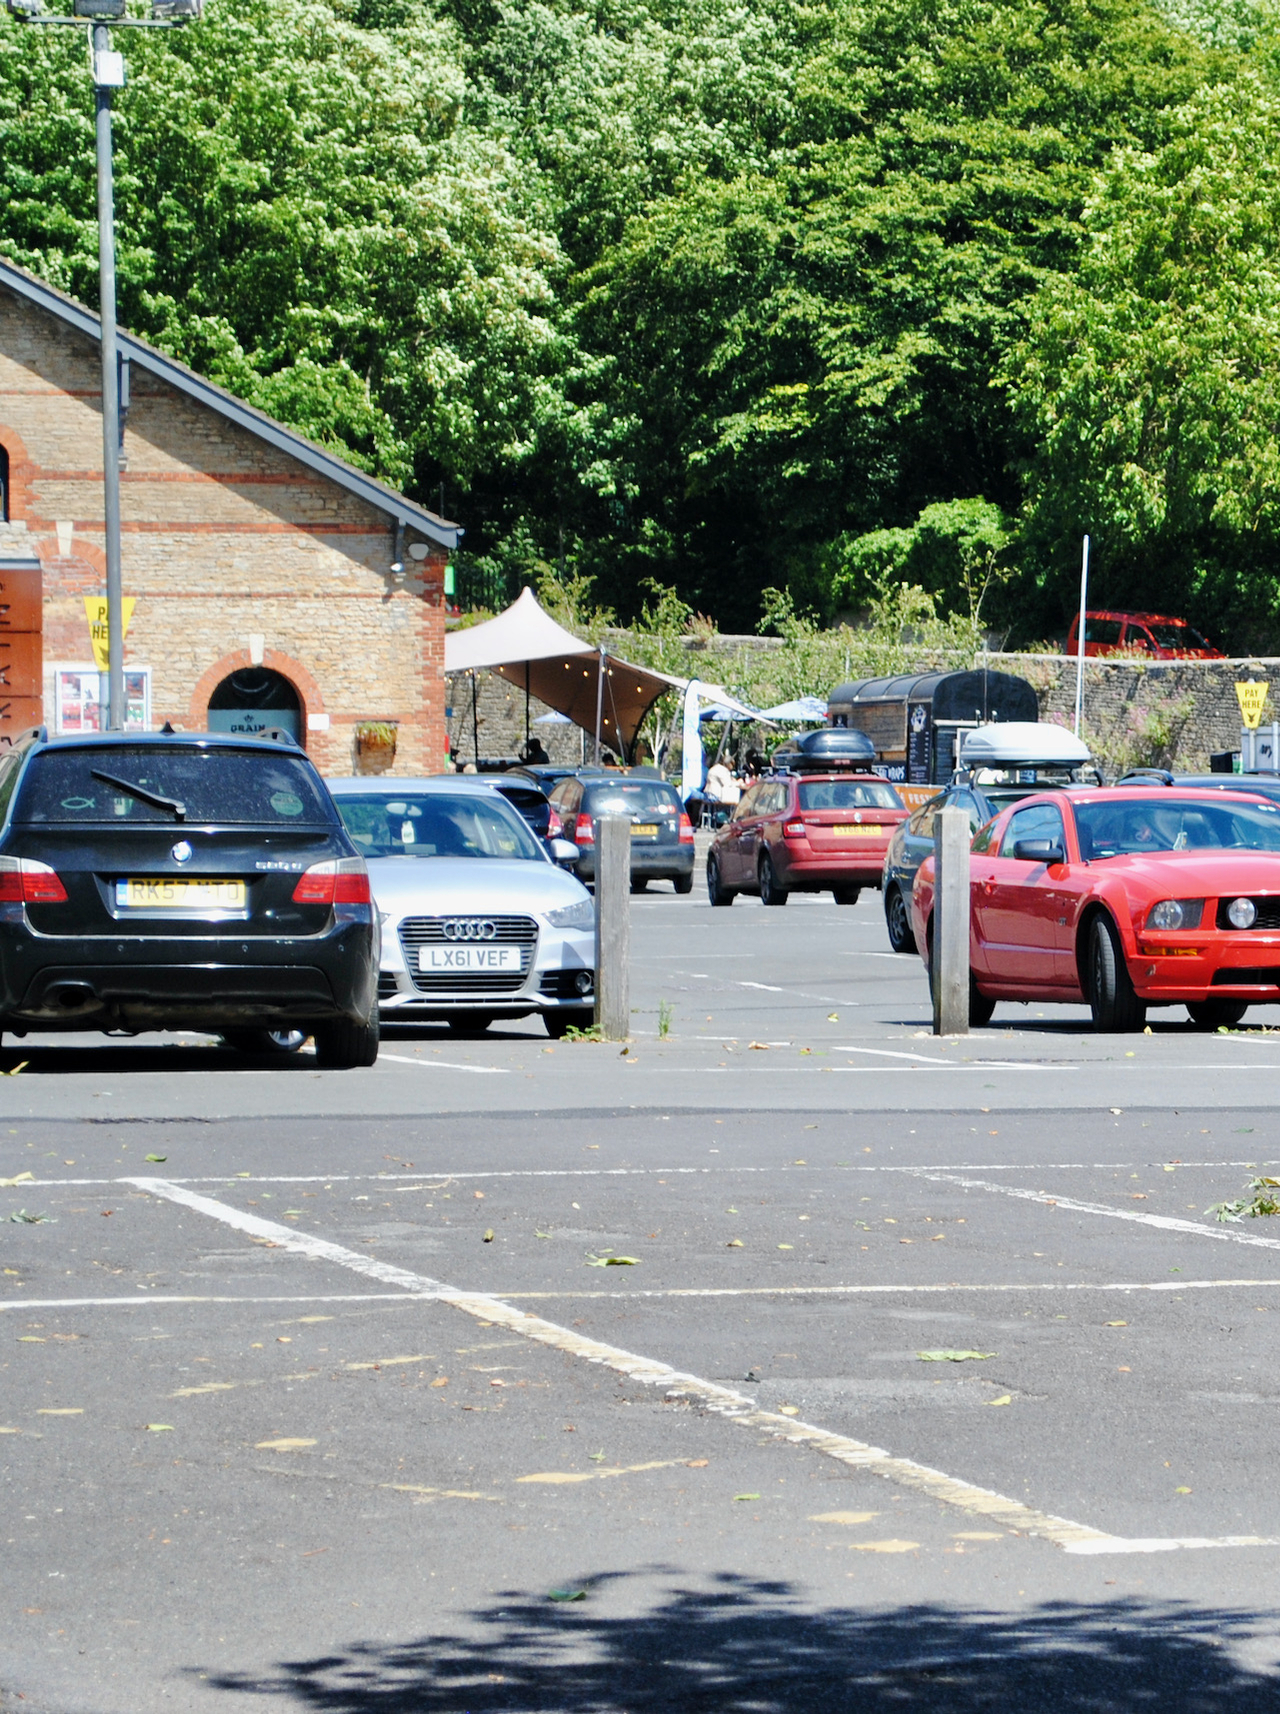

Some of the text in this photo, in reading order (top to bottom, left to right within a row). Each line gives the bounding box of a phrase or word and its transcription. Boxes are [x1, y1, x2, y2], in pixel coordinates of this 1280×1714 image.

[1244, 688, 1259, 698] PAY
[1241, 700, 1261, 709] HERE
[431, 950, 510, 967] LX61 VEF
